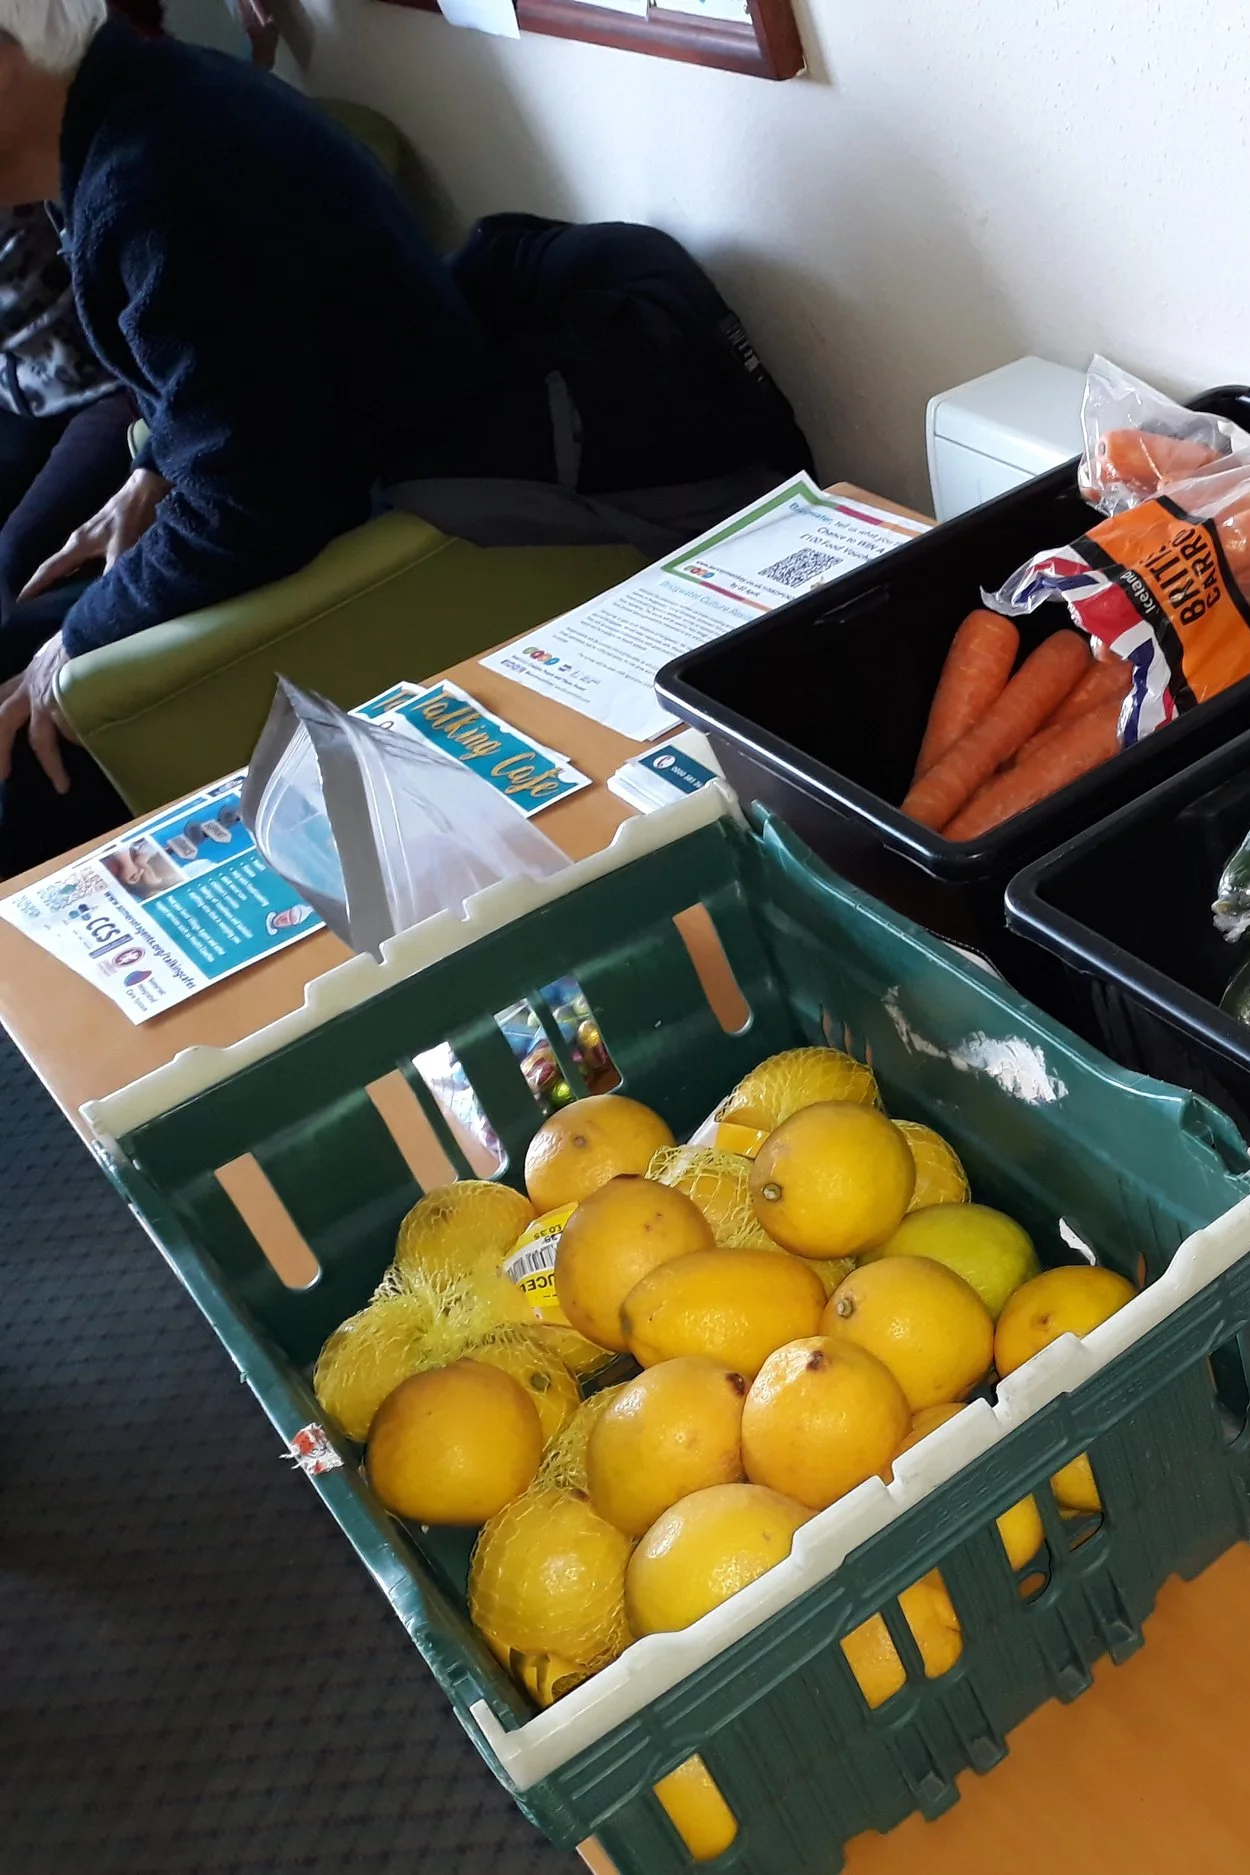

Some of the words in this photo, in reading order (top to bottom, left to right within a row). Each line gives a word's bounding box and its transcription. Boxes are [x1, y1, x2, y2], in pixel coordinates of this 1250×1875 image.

[1120, 570, 1157, 615] Iceland
[411, 688, 502, 761] Talking
[86, 916, 121, 943] CCS
